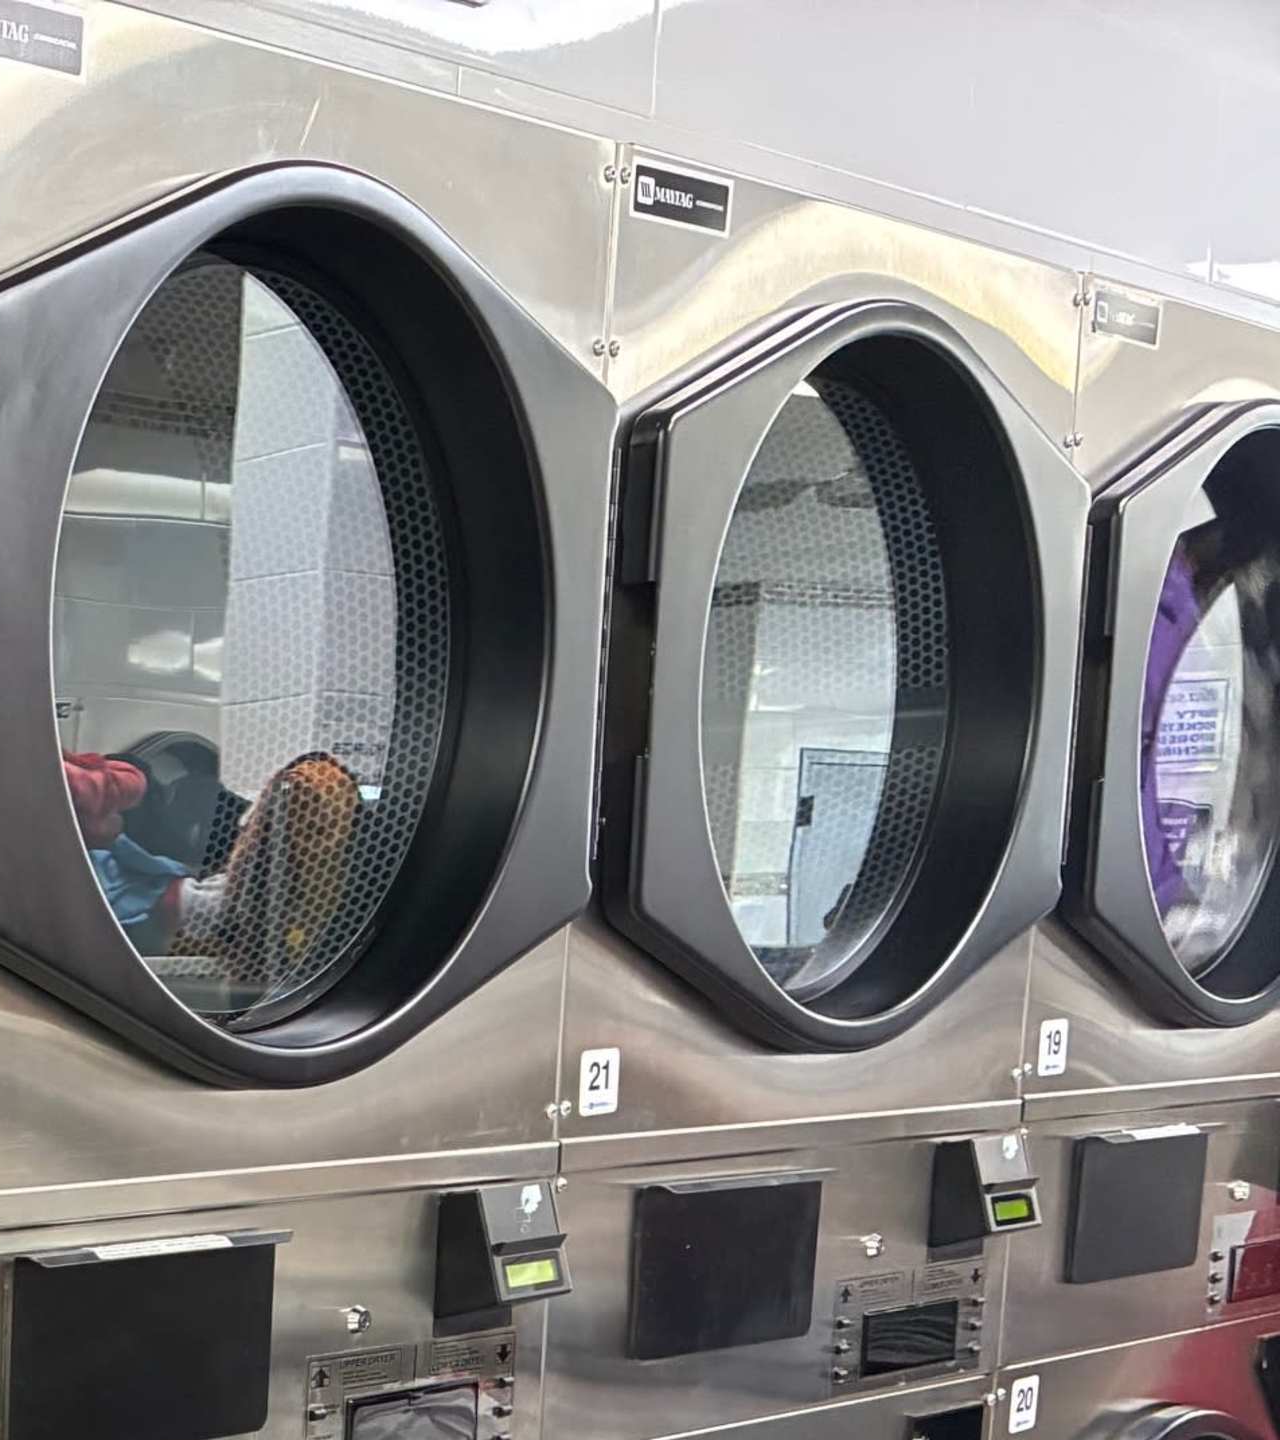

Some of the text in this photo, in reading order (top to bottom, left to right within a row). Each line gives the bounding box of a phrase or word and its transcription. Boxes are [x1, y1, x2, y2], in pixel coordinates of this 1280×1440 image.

[654, 186, 694, 209] MAYTAG
[1045, 1030, 1061, 1055] 19
[588, 1061, 611, 1091] 21
[1017, 1386, 1034, 1413] 20
